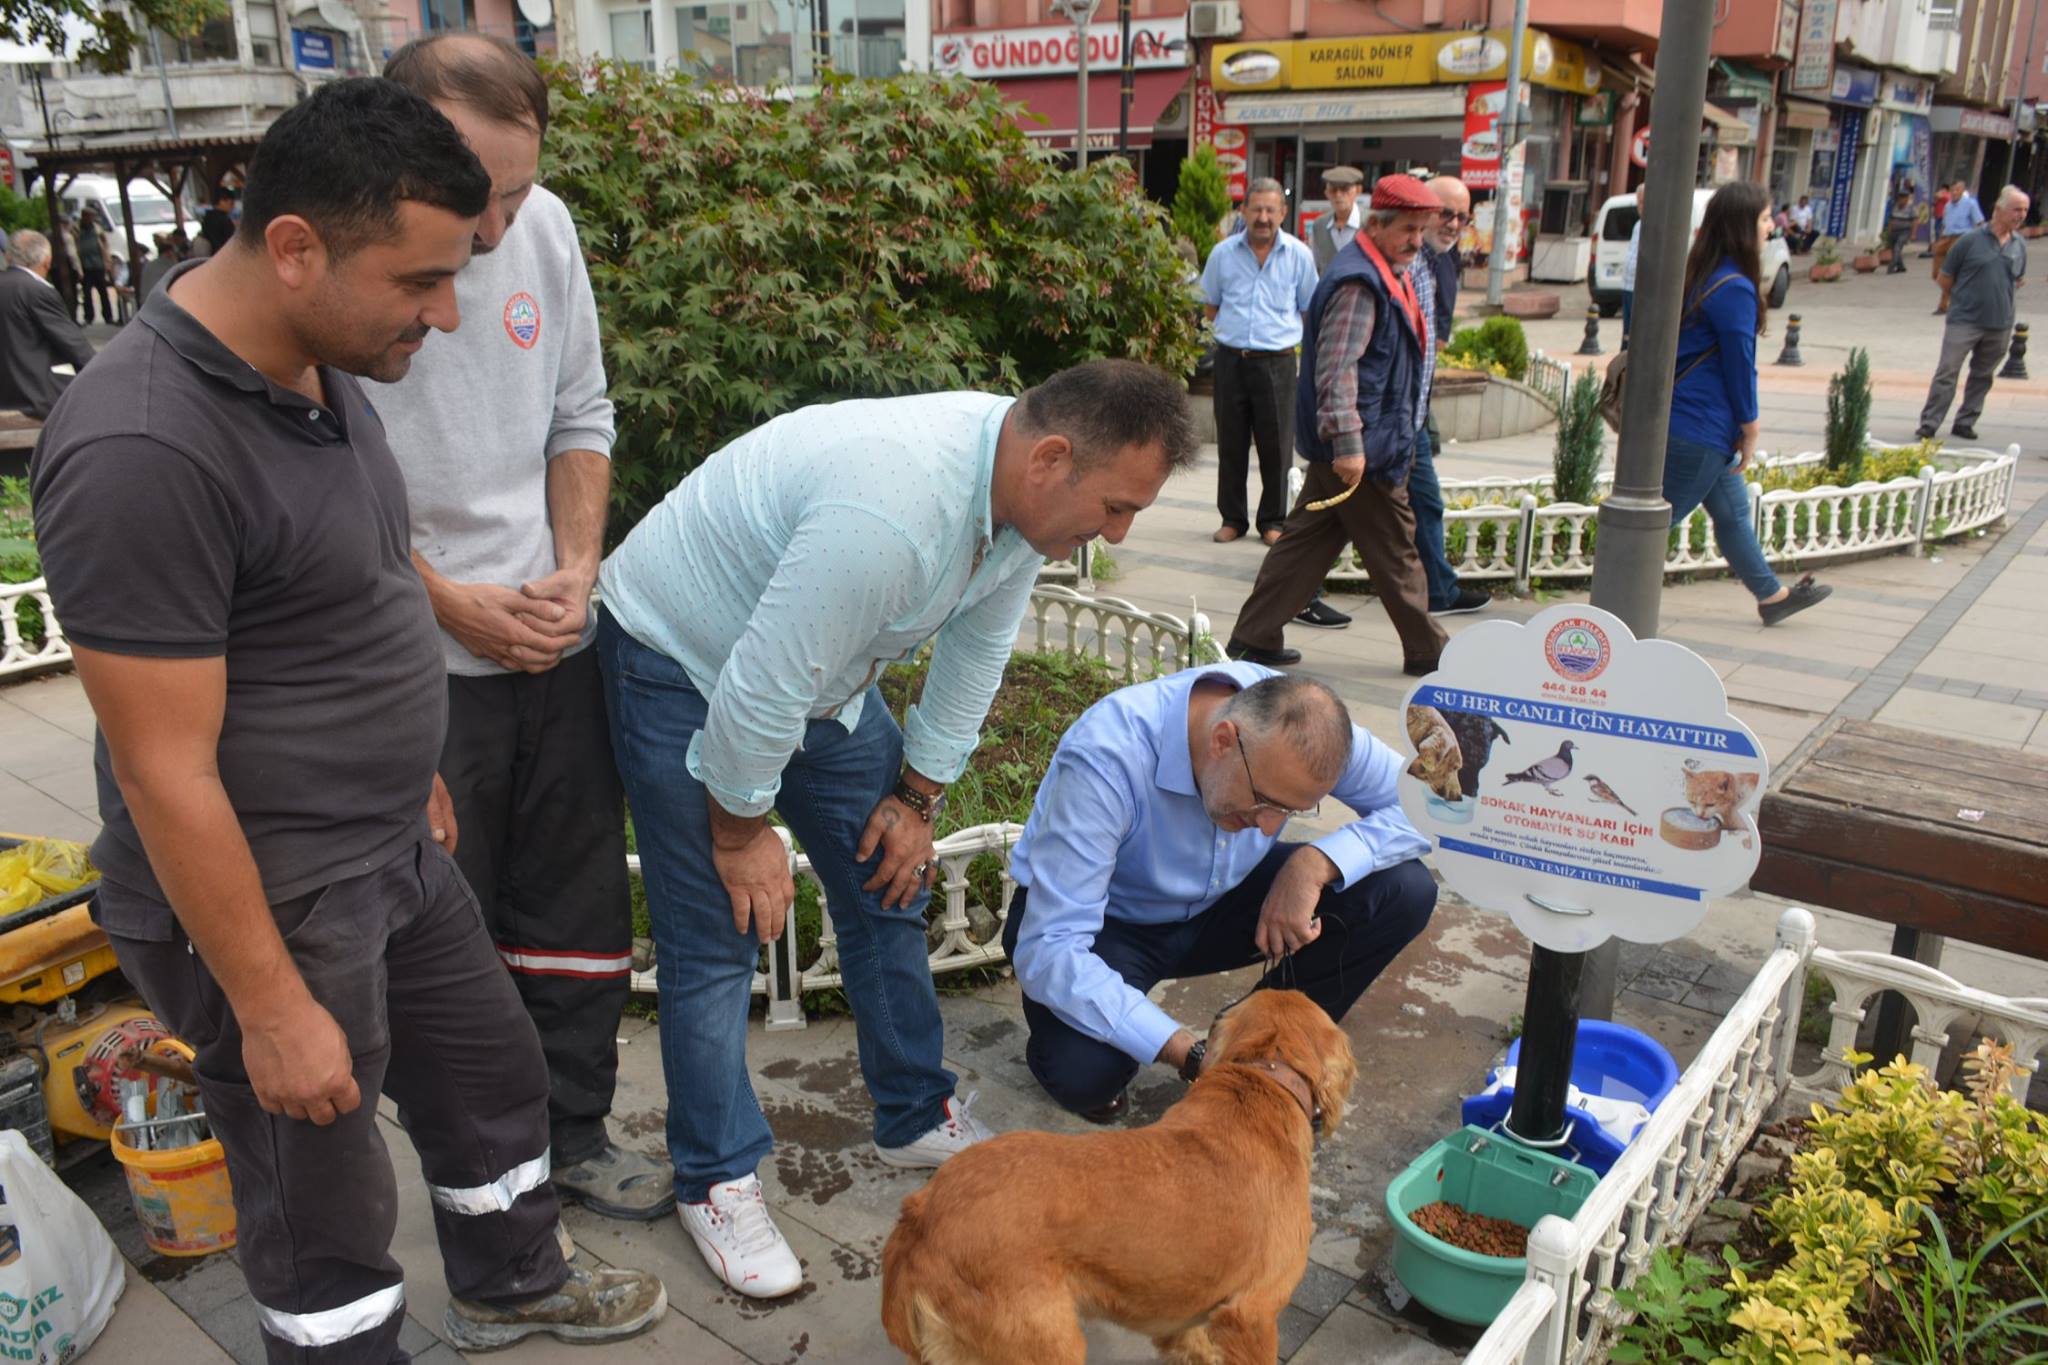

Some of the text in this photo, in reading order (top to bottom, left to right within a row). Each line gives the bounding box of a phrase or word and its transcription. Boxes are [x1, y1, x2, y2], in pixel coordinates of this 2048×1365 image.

[1309, 43, 1414, 64] KARAGÜL DÖNER
[1335, 65, 1384, 81] SALONU
[1542, 681, 1608, 699] 444 28 44
[1432, 689, 1729, 749] SU HER CANLI İÇİN HAYATTIR
[1480, 795, 1654, 837] SOKAK HAYVANLARI İÇİN
[1503, 814, 1574, 837] OTOMATİK
[1576, 828, 1597, 841] SU
[1492, 850, 1641, 890] LÜTFEN TEMİZ TUTALIM!
